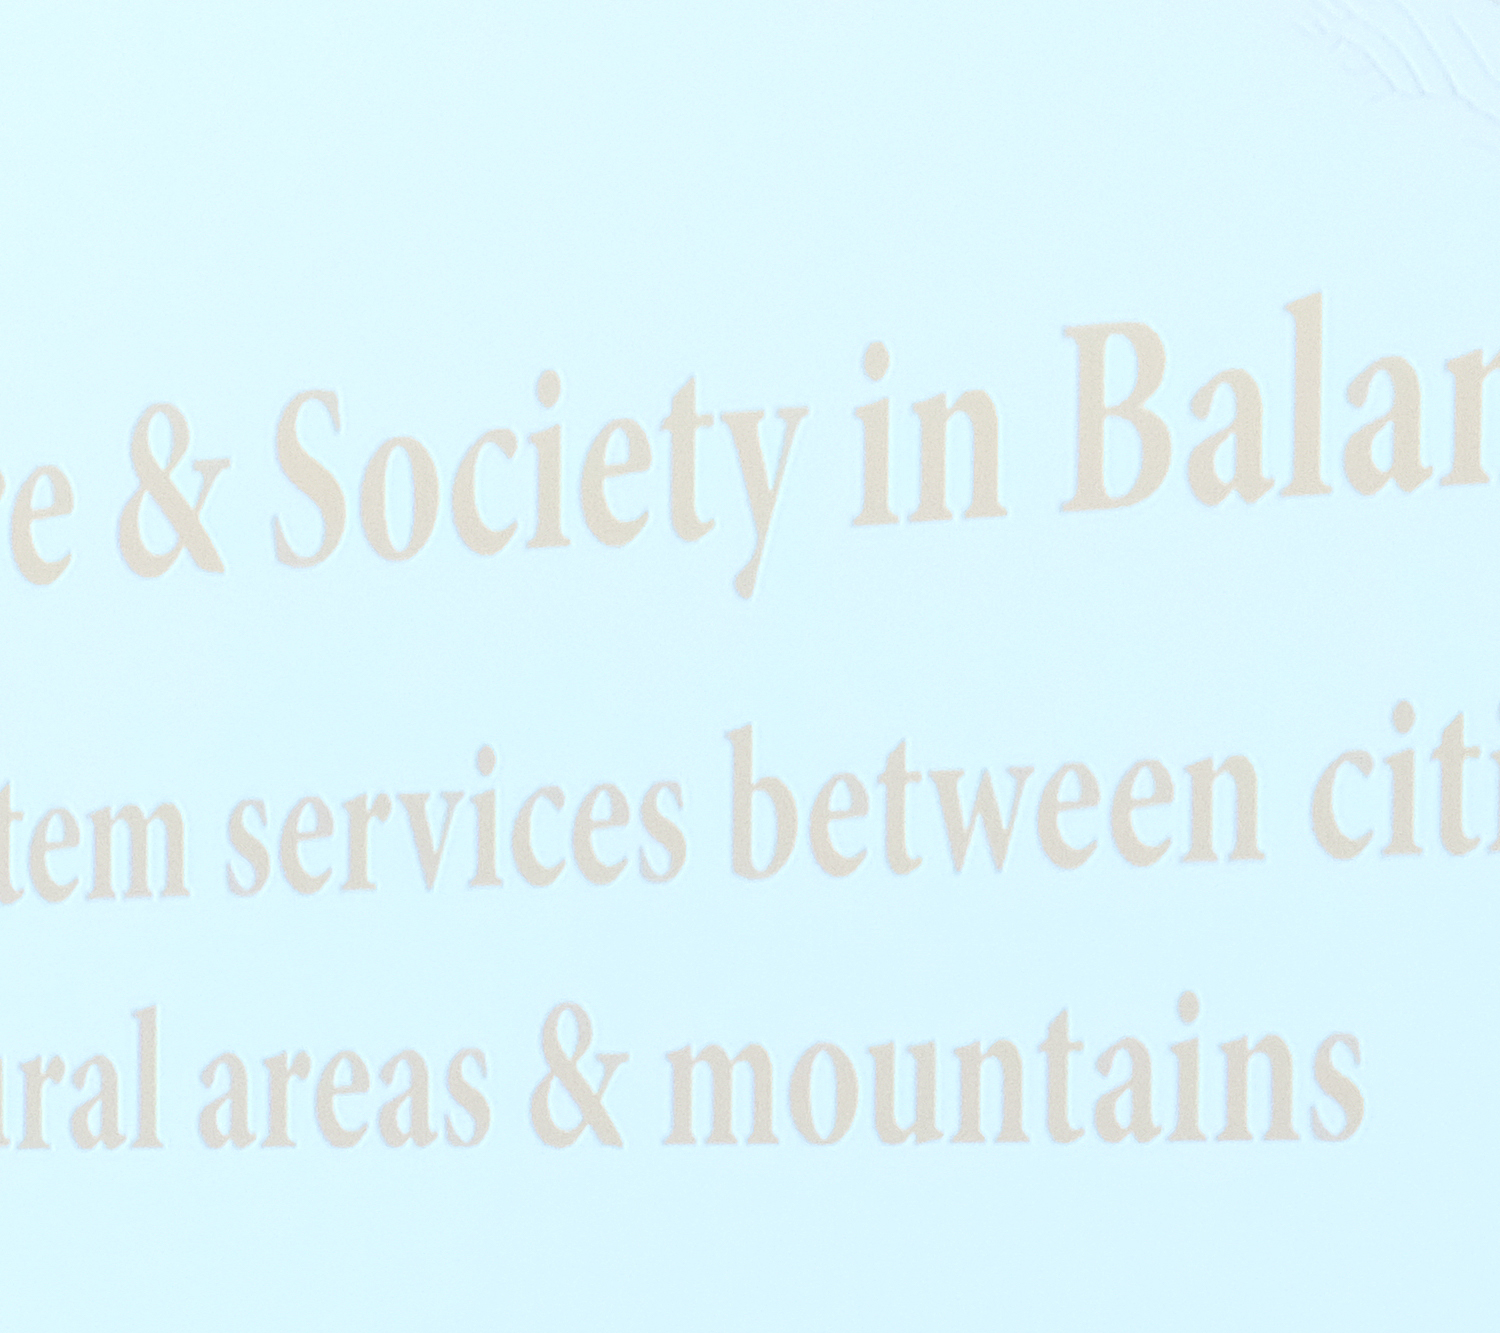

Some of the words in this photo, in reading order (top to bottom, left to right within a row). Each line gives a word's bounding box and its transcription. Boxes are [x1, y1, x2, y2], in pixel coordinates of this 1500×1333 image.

[115, 402, 231, 579] &
[270, 368, 809, 600] Society
[850, 340, 1007, 527] in
[225, 744, 688, 897] services
[724, 721, 1266, 880] between
[198, 1046, 491, 1150] areas
[528, 1000, 630, 1150] &
[661, 989, 1366, 1145] mountains
